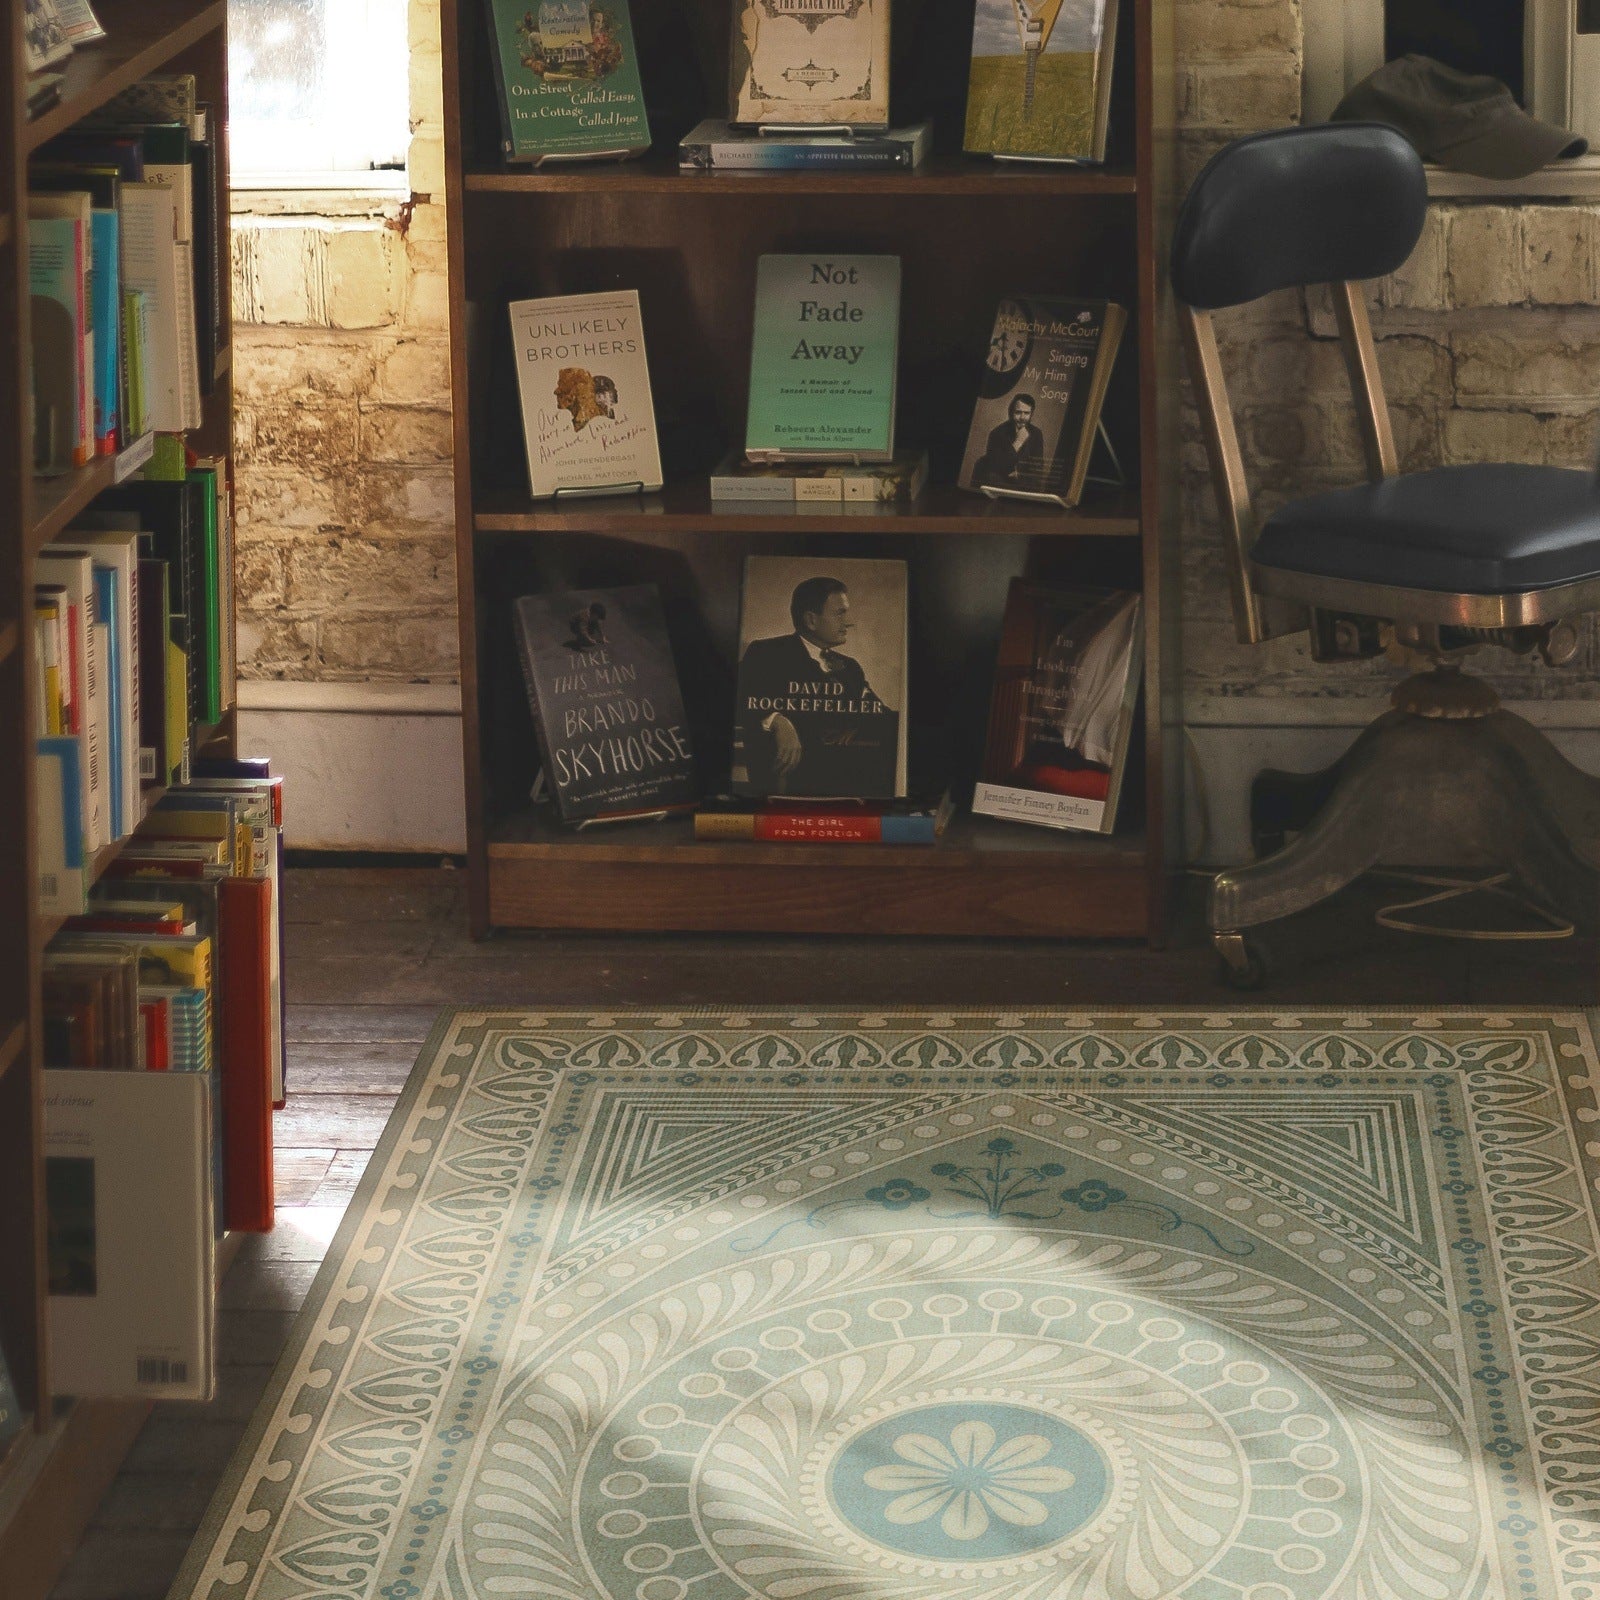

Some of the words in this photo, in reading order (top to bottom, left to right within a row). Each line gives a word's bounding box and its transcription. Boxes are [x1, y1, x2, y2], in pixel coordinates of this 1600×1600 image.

[778, 0, 795, 9] THE
[798, 0, 825, 9] BLACK
[826, 0, 845, 9] VEIL
[549, 25, 581, 36] Comedy
[511, 86, 530, 96] On
[539, 82, 572, 95] Street
[571, 90, 606, 105] Called
[608, 91, 636, 103] Easy,
[516, 108, 529, 119] In
[540, 106, 584, 119] Cottage
[578, 111, 613, 127] Called
[614, 112, 639, 126] Joye
[810, 264, 858, 285] Not
[798, 301, 863, 323] Fade
[529, 318, 628, 339] UNLIKELY
[998, 316, 1046, 334] Malachy
[1050, 321, 1099, 337] McCourt
[527, 340, 637, 362] BROTHERS
[790, 338, 864, 365] Away
[1048, 349, 1088, 368] Singing
[1023, 367, 1041, 381] My
[1044, 369, 1067, 381] Him
[1040, 385, 1068, 403] Song
[537, 408, 560, 432] Our
[774, 424, 815, 433] Rebecca
[819, 424, 872, 434] Alexander
[555, 459, 577, 467] JOHN
[557, 473, 592, 483] MICHAEL
[569, 649, 611, 671] TAKE
[1036, 657, 1083, 677] Looking
[553, 673, 587, 694] THIS
[595, 663, 637, 685] MAN
[789, 680, 843, 695] DAVID
[1022, 680, 1068, 701] Through
[747, 696, 884, 714] ROCKEFELLER
[564, 698, 656, 739] BRANDO
[555, 725, 693, 787] SKYHORSE
[983, 790, 1022, 806] Jennifer
[1024, 797, 1055, 811] Finney
[1057, 801, 1090, 816] Boylan
[791, 818, 812, 826] THE
[818, 818, 844, 827] GIRL
[775, 829, 806, 837] FROM
[811, 830, 862, 838] FOREIGN
